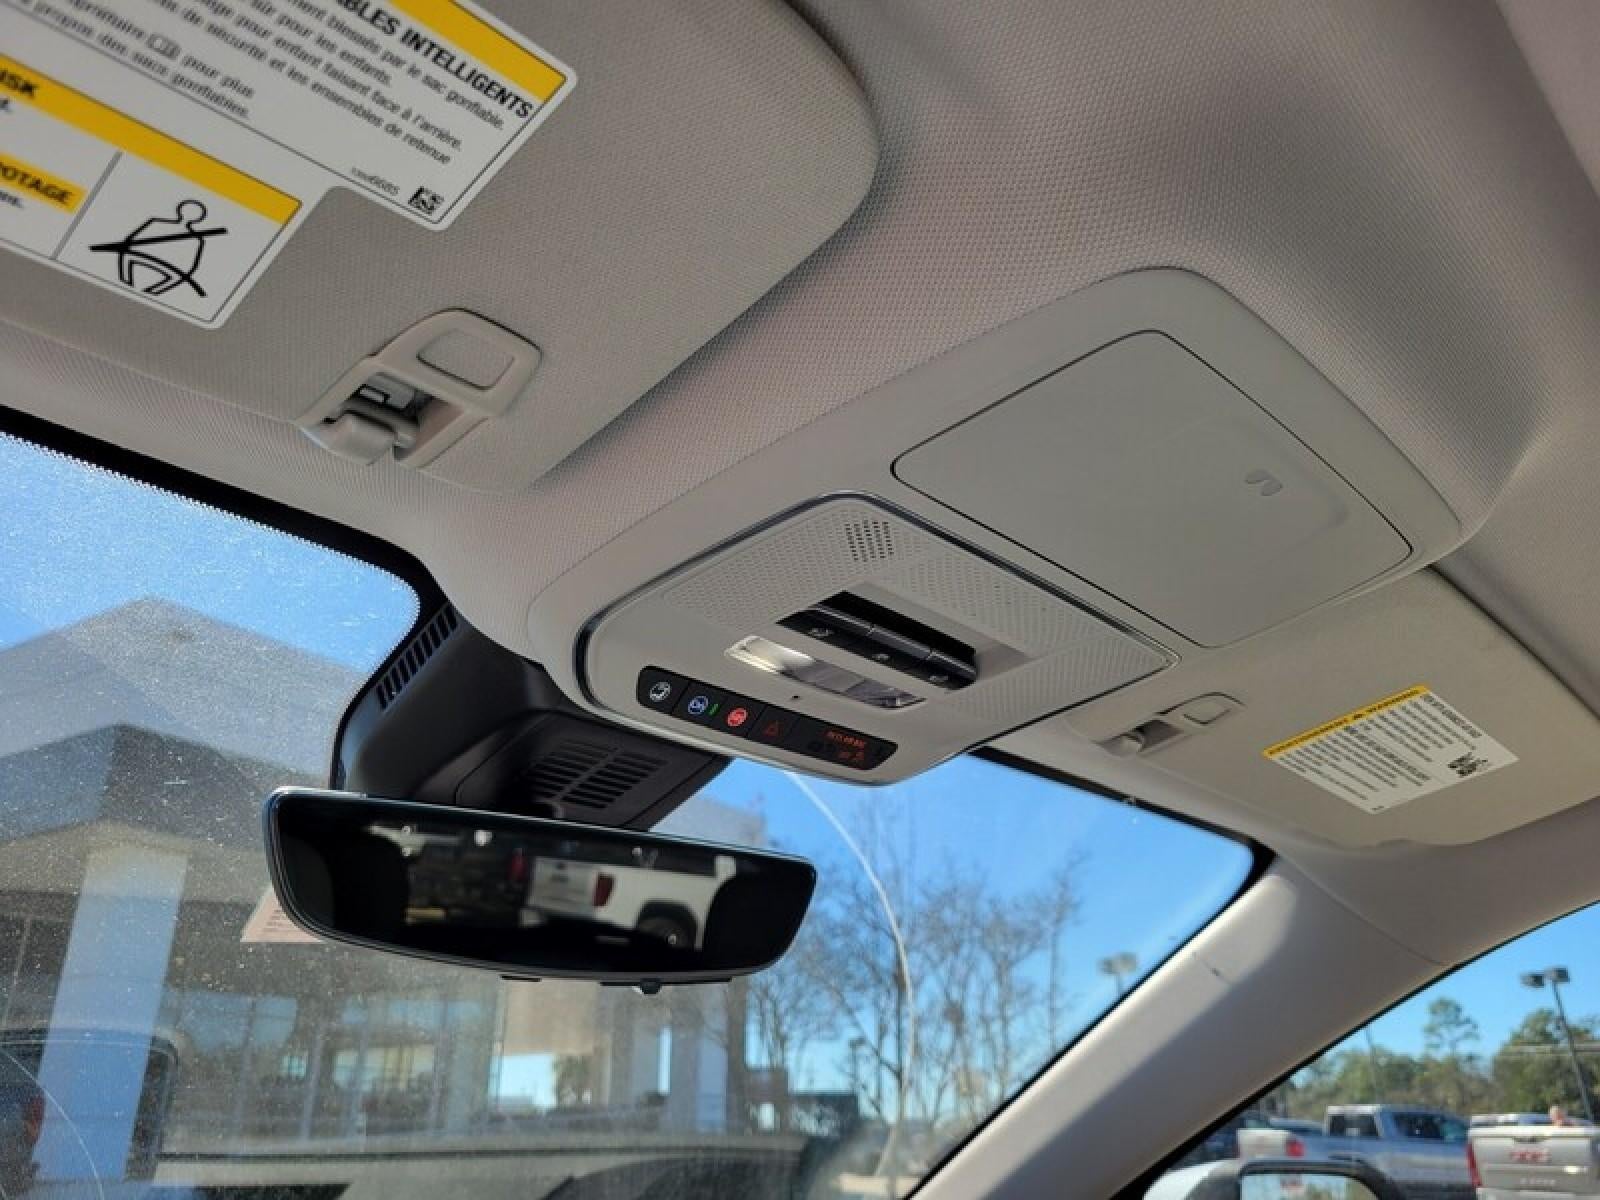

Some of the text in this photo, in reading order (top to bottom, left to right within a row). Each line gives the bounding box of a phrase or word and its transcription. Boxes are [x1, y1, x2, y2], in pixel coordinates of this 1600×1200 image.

[0, 70, 38, 98] ISK
[132, 51, 169, 77] sacs
[181, 8, 204, 25] de
[205, 21, 268, 61] sécurité
[269, 56, 288, 73] et
[287, 65, 309, 85] les
[311, 81, 384, 127] ensembles
[384, 123, 402, 138] de
[402, 133, 451, 165] retenue
[182, 55, 219, 78] pour
[220, 75, 254, 98] plus
[234, 14, 272, 40] pour
[273, 36, 322, 69] enfant
[322, 62, 371, 95] faisant
[371, 91, 400, 113] face
[401, 106, 413, 121] à
[277, 15, 313, 38] pour
[315, 33, 338, 52] les
[339, 49, 391, 87] enfants.
[327, 15, 381, 54] blessés
[381, 50, 406, 68] par
[407, 64, 421, 78] le
[421, 74, 447, 94] sac
[446, 90, 503, 130] gonflable.
[336, 0, 533, 118] BLES INTELLIGENTS
[0, 162, 72, 203] OTAGE
